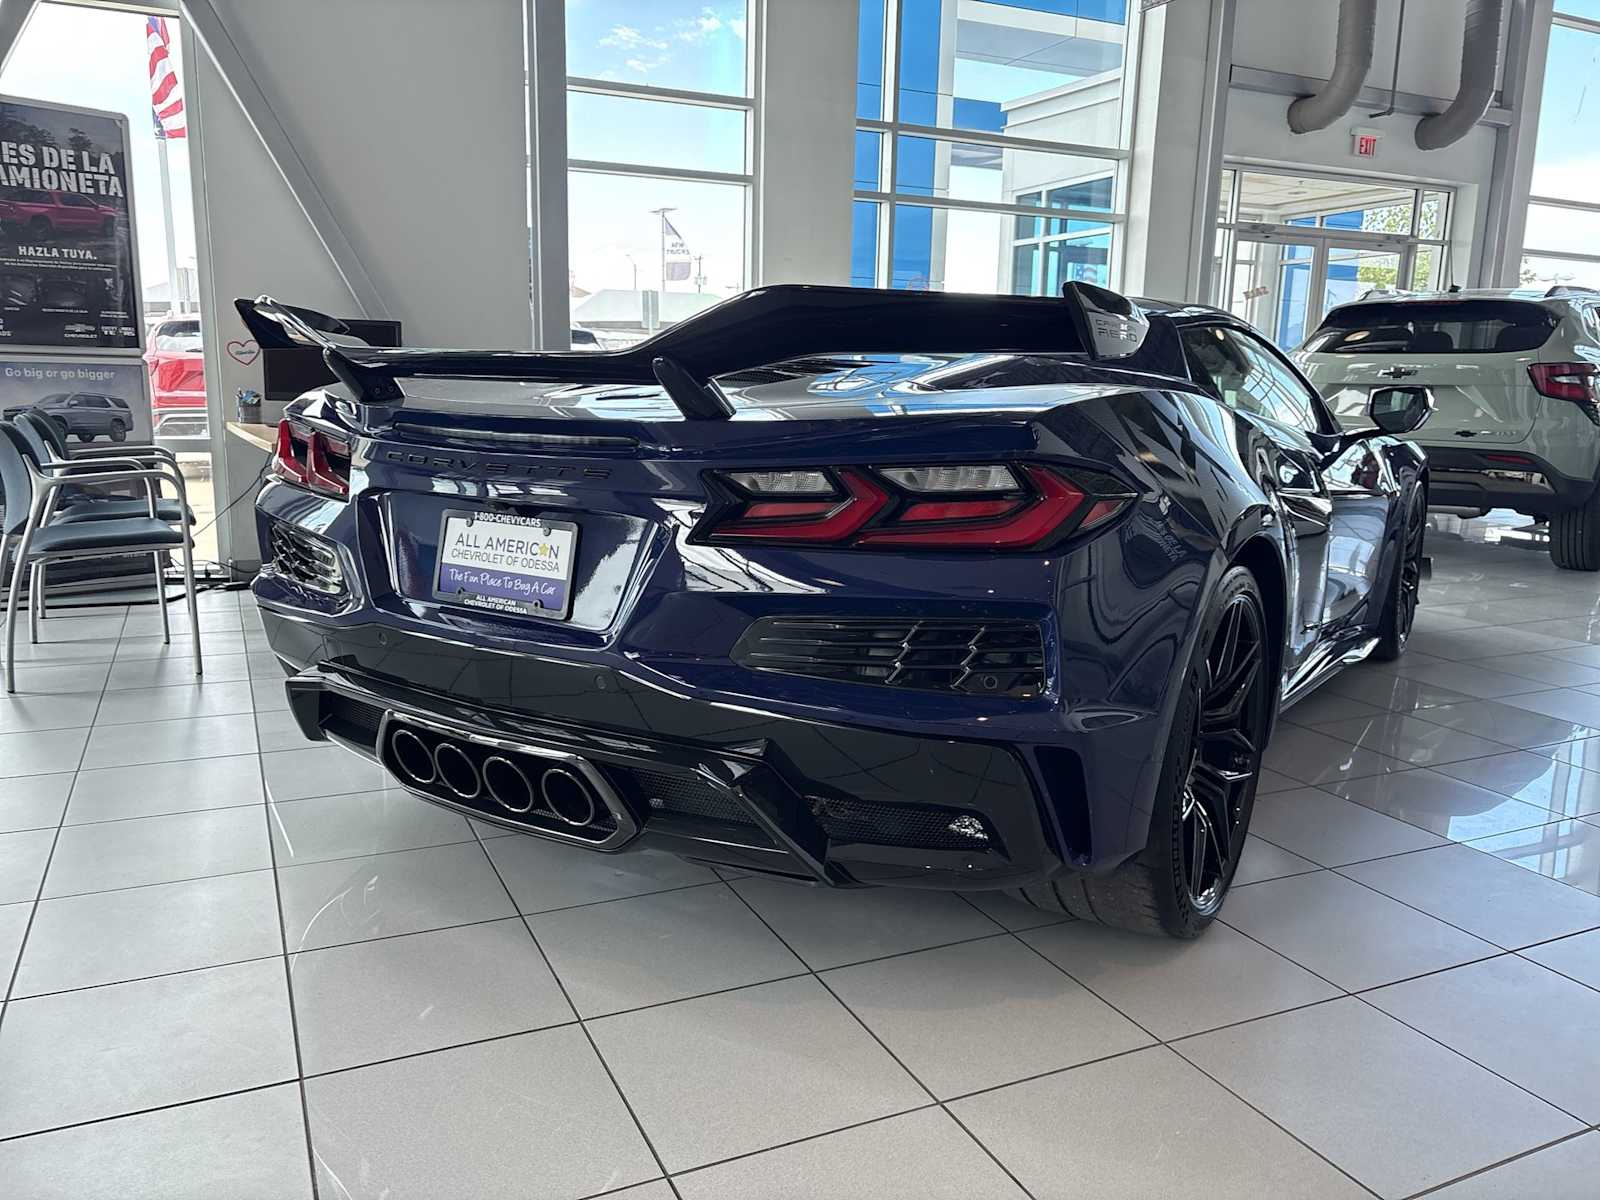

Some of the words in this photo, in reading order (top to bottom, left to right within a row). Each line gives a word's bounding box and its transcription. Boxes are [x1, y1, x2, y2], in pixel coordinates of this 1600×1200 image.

[1360, 137, 1377, 156] EXIT
[1, 140, 36, 167] ES
[42, 146, 77, 171] DE
[82, 151, 116, 174] LA
[18, 246, 60, 258] HAZLA
[61, 248, 98, 260] TUYA.
[4, 367, 21, 377] Go
[23, 367, 44, 380] big
[46, 369, 59, 378] or
[60, 370, 75, 380] go
[76, 368, 115, 380] bigger
[387, 451, 613, 480] CORVETTE
[474, 511, 542, 528] 1-800-CHEVYCARS
[455, 532, 481, 549] ALL
[451, 548, 504, 565] CHEVROLET
[506, 555, 518, 567] OF
[521, 557, 560, 573] ODESSA
[449, 568, 463, 581] The
[480, 572, 503, 587] Place
[503, 576, 513, 588] To
[531, 582, 539, 593] A
[540, 582, 557, 595] Car
[464, 599, 496, 609] CHEVROLET
[505, 605, 528, 615] ODESSA
[476, 594, 487, 602] ALL
[487, 596, 517, 606] AMERICAN
